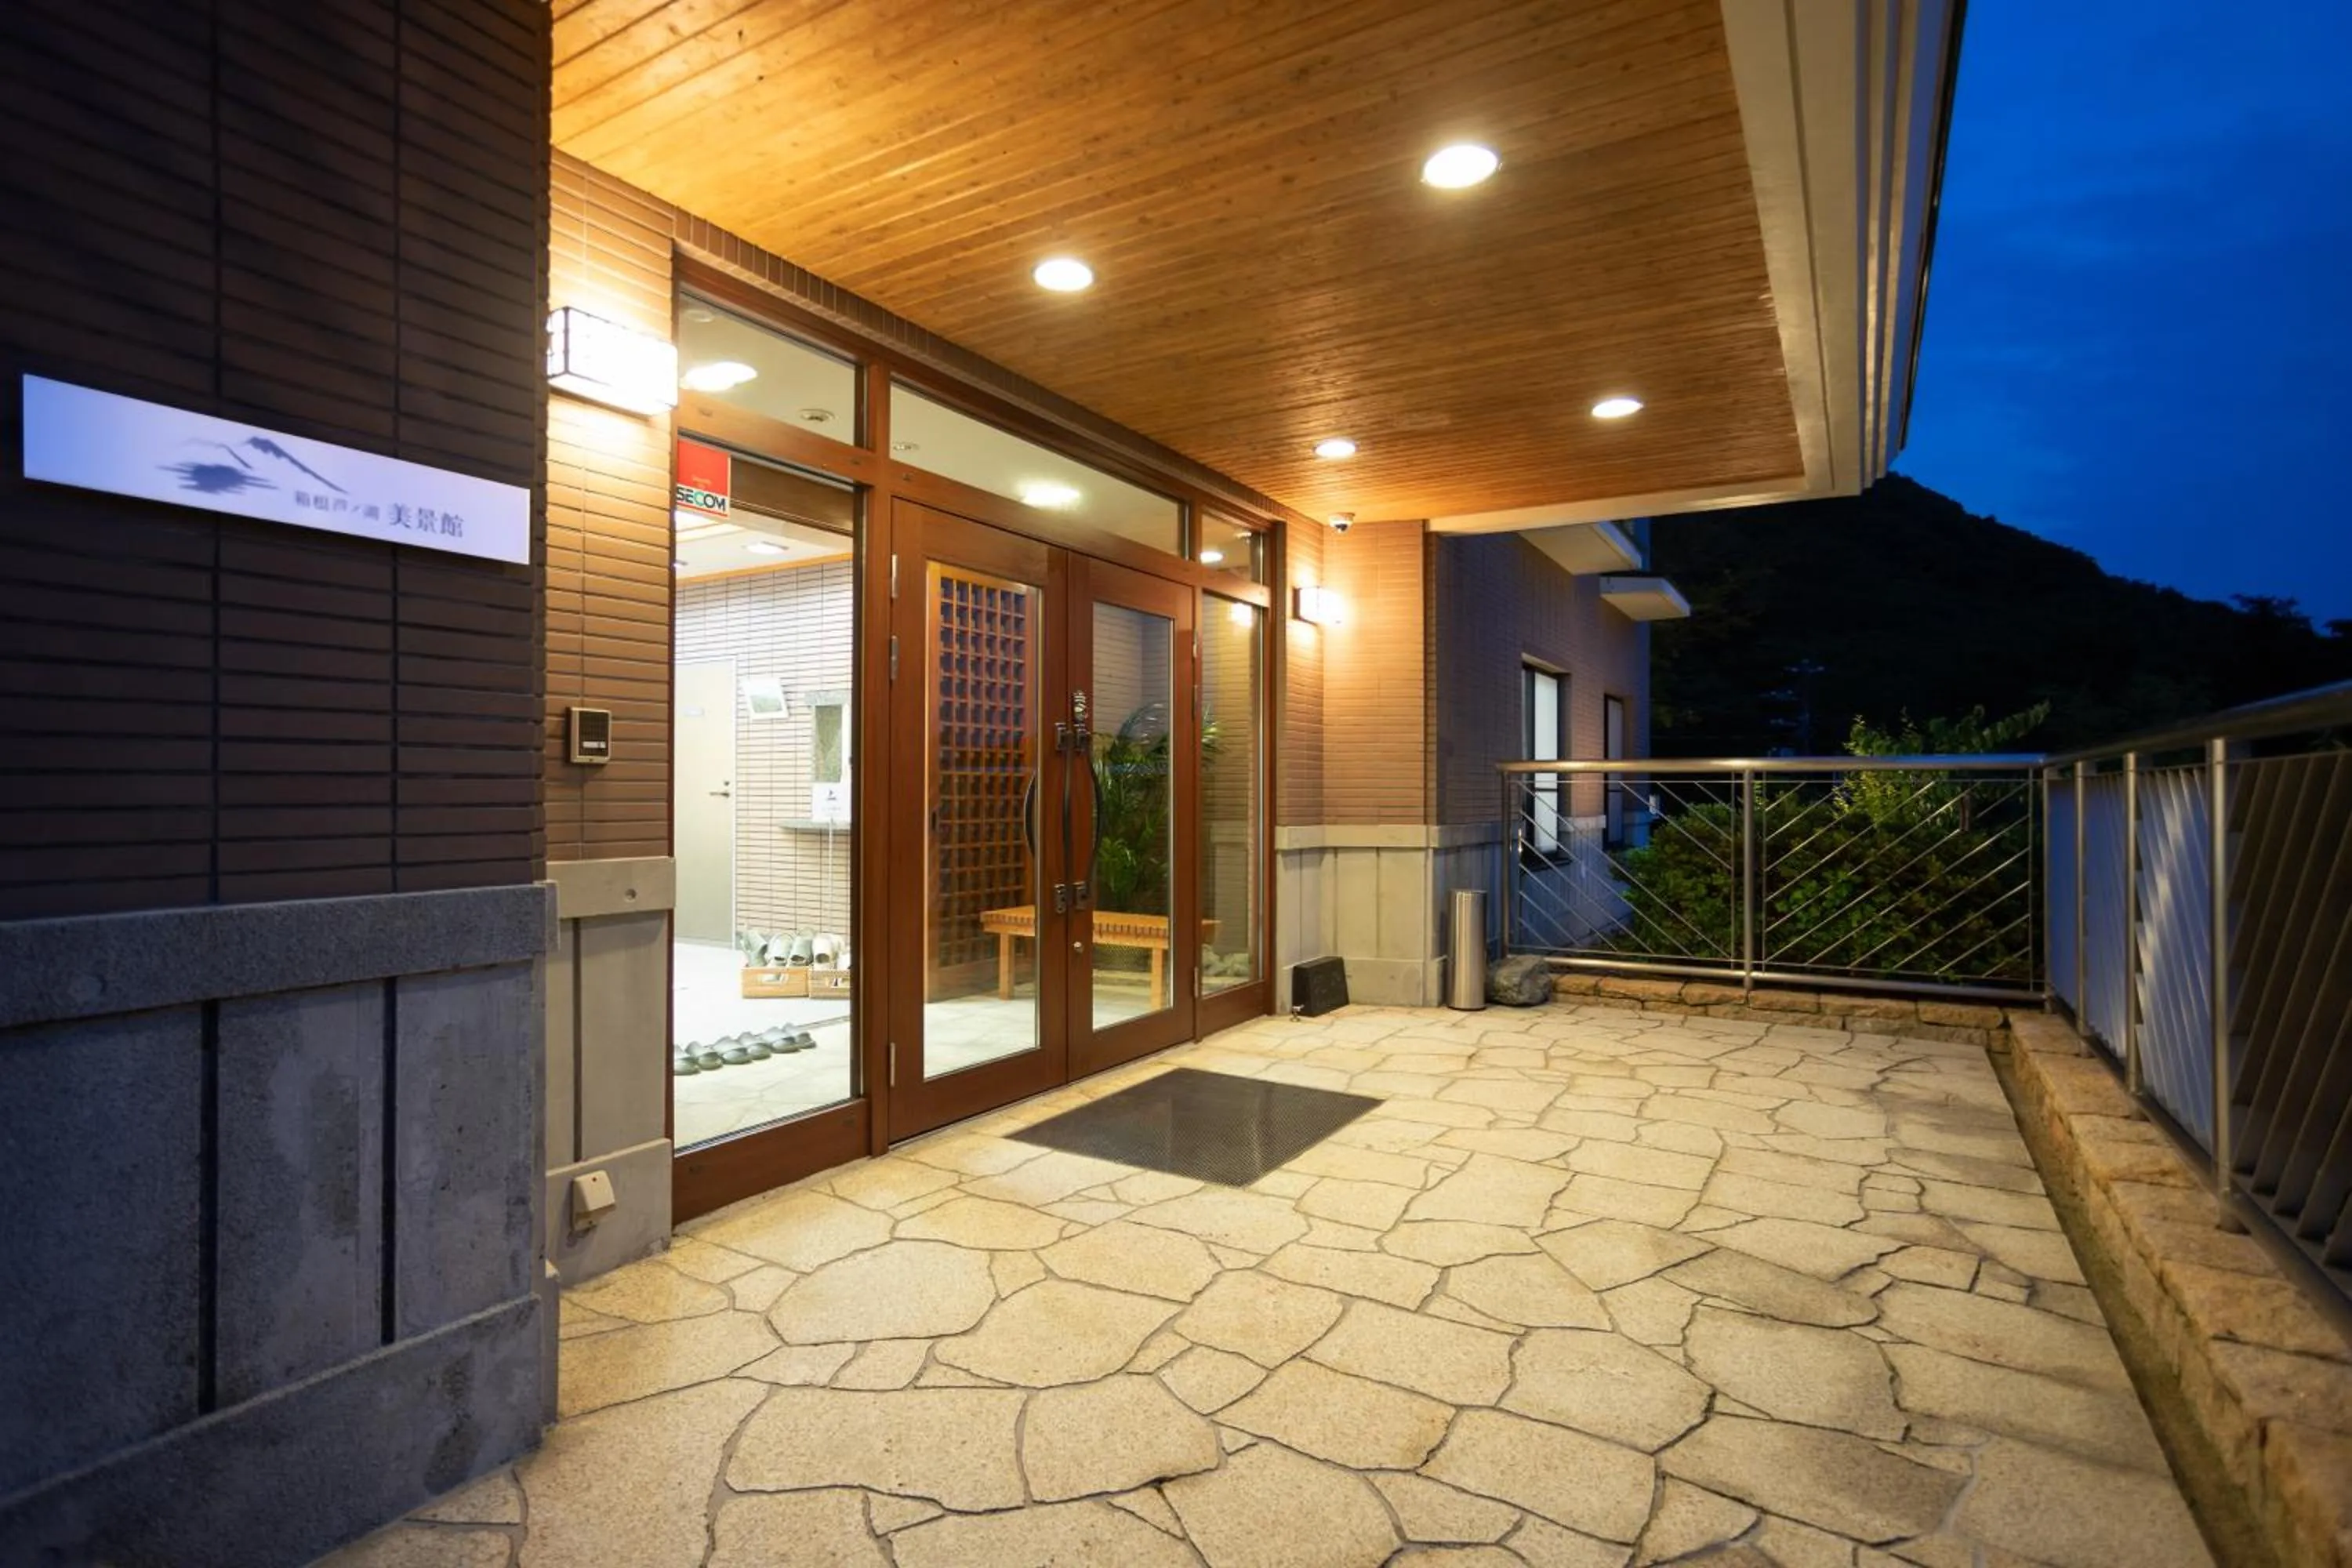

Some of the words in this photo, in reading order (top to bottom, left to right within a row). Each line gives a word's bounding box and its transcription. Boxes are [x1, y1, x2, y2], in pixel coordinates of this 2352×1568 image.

[677, 486, 725, 511] SECOM
[389, 503, 464, 538] 美景館
